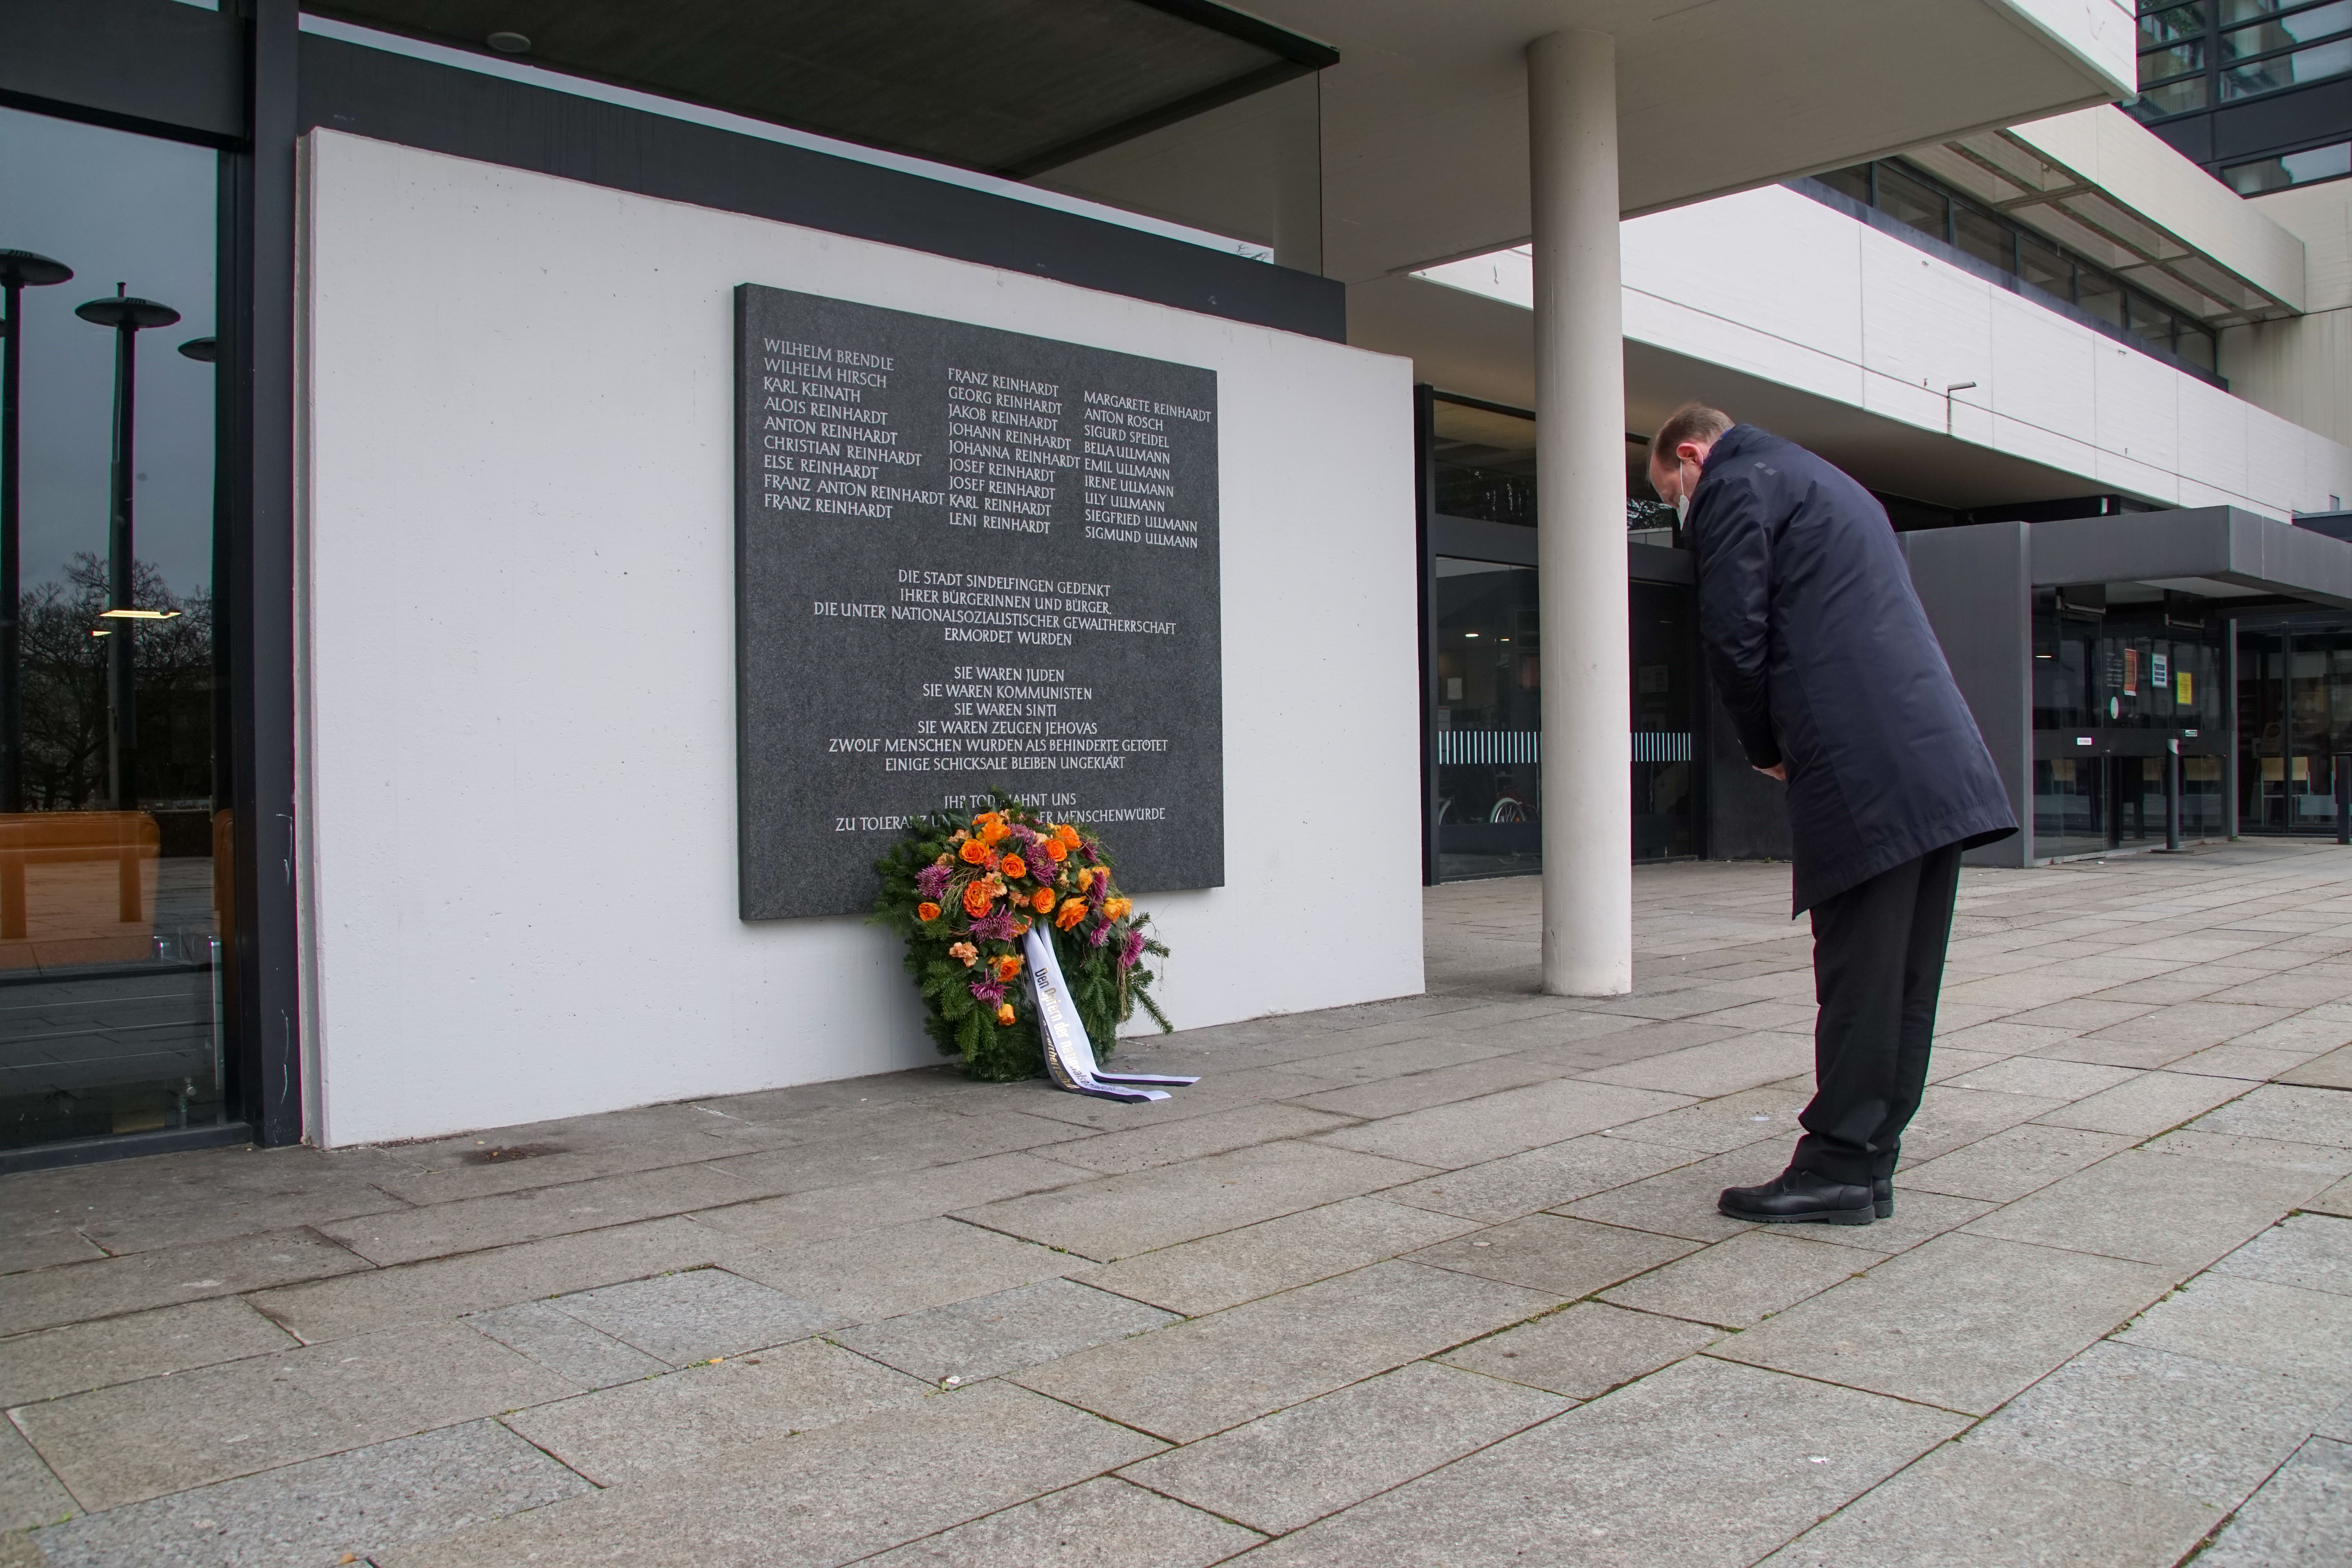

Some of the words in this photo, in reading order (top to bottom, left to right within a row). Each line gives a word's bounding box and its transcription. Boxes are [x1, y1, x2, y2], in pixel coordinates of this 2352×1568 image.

[764, 338, 832, 361] WILHELM
[837, 350, 894, 371] BRENDLE
[764, 357, 832, 380] WILHELM
[837, 368, 886, 388] HIRSCH
[948, 367, 988, 386] FRANZ
[993, 375, 1059, 397] REINHARDT
[764, 376, 798, 394] KARL
[802, 382, 860, 403] KEINATH
[948, 386, 991, 404] GEORG
[996, 393, 1063, 415] REINHARDT
[764, 396, 806, 414] ALOIS
[810, 402, 888, 425] REINHARDT
[948, 403, 986, 421] JAKOB
[992, 410, 1058, 431] REINHARDT
[1084, 390, 1150, 413] MARGARETE
[1154, 402, 1211, 423] REINHARDT
[1084, 407, 1123, 425] ANTON
[1127, 414, 1163, 431] ROSCH
[764, 416, 816, 434] ANTON
[821, 422, 898, 445] REINHARDT
[949, 421, 1001, 441] JOHANN
[1006, 430, 1072, 450] REINHARDT
[1084, 425, 1126, 441] SIGURD
[1129, 431, 1169, 448] SPEIDEL
[764, 435, 840, 456] CHRISTIAN
[847, 445, 922, 466] REINHARDT
[949, 439, 1011, 460] JOHANNA
[1015, 448, 1081, 469] REINHARDT
[1084, 441, 1115, 457] BELLA
[1116, 446, 1170, 464] ULLMANN
[764, 454, 794, 470] ELSE
[800, 458, 879, 480] REINHARDT
[949, 457, 985, 474] JOSEF
[989, 463, 1056, 483] REINHARDT
[1085, 458, 1113, 473] EMIL
[1116, 462, 1170, 481] ULLMANN
[764, 474, 811, 492] FRANZ
[817, 480, 866, 497] ANTON
[871, 485, 946, 505] REINHARDT
[949, 475, 985, 492] JOSEF
[989, 480, 1056, 500] REINHARDT
[1085, 475, 1117, 490] IRENE
[1120, 479, 1174, 497] ULLMANN
[764, 493, 811, 511] FRANZ
[815, 498, 893, 519] REINHARDT
[949, 494, 979, 509] KARL
[984, 497, 1052, 517] REINHARDT
[1085, 492, 1107, 506] LILY
[1111, 495, 1165, 512] ULLMANN
[949, 512, 976, 527] LENI
[983, 515, 1051, 534] REINHARDT
[1085, 508, 1141, 526] SIEGFRIED
[1145, 515, 1198, 532] ULLMANN
[1085, 526, 1141, 543] SIGMUND
[1145, 532, 1198, 548] ULLMANN
[898, 569, 920, 583] DIE
[924, 571, 963, 586] STADT
[967, 574, 1053, 592] SINDELFINGEN
[1057, 581, 1111, 597] GEDENKT
[900, 588, 940, 604] IHRER
[1035, 597, 1062, 610] UND
[814, 601, 838, 616] DIE
[841, 603, 887, 619] UNTER
[891, 606, 1060, 628] NATIONALSOZIALISTISCHER
[1063, 616, 1176, 635] GEWALTHERRSCHAFT
[944, 628, 1013, 643] ERMORDET
[1017, 631, 1072, 646] WURDEN
[955, 666, 973, 679] SIE
[975, 666, 1022, 681] WAREN
[1026, 668, 1064, 682] JUDEN
[923, 683, 943, 697] SIE
[945, 684, 992, 698] WAREN
[996, 684, 1092, 700] KOMMUNISTEN
[954, 702, 973, 715] SIE
[976, 702, 1022, 716] WAREN
[1026, 704, 1057, 717] SINTI
[918, 720, 937, 734] SIE
[940, 720, 988, 734] WAREN
[991, 721, 1042, 734] ZEUGEN
[1045, 722, 1098, 737] JEHOVAS
[885, 739, 962, 752] MENSCHEN
[965, 739, 1023, 752] WURDEN
[1025, 739, 1046, 751] ALS
[1049, 739, 1119, 752] BEHINDERTE
[886, 758, 930, 771] EINIGE
[933, 757, 1007, 770] SCHICKSALE
[1011, 757, 1056, 769] BLEIBEN
[944, 795, 966, 809] IHR
[969, 795, 995, 808] TOD
[1051, 793, 1076, 806] UNS
[835, 817, 855, 831] ZU
[931, 815, 951, 828] UN
[1039, 811, 1054, 824] ER
[1035, 967, 1049, 989] Den
[1053, 1022, 1070, 1039] der
[1042, 1020, 1081, 1090] altherrschaft
